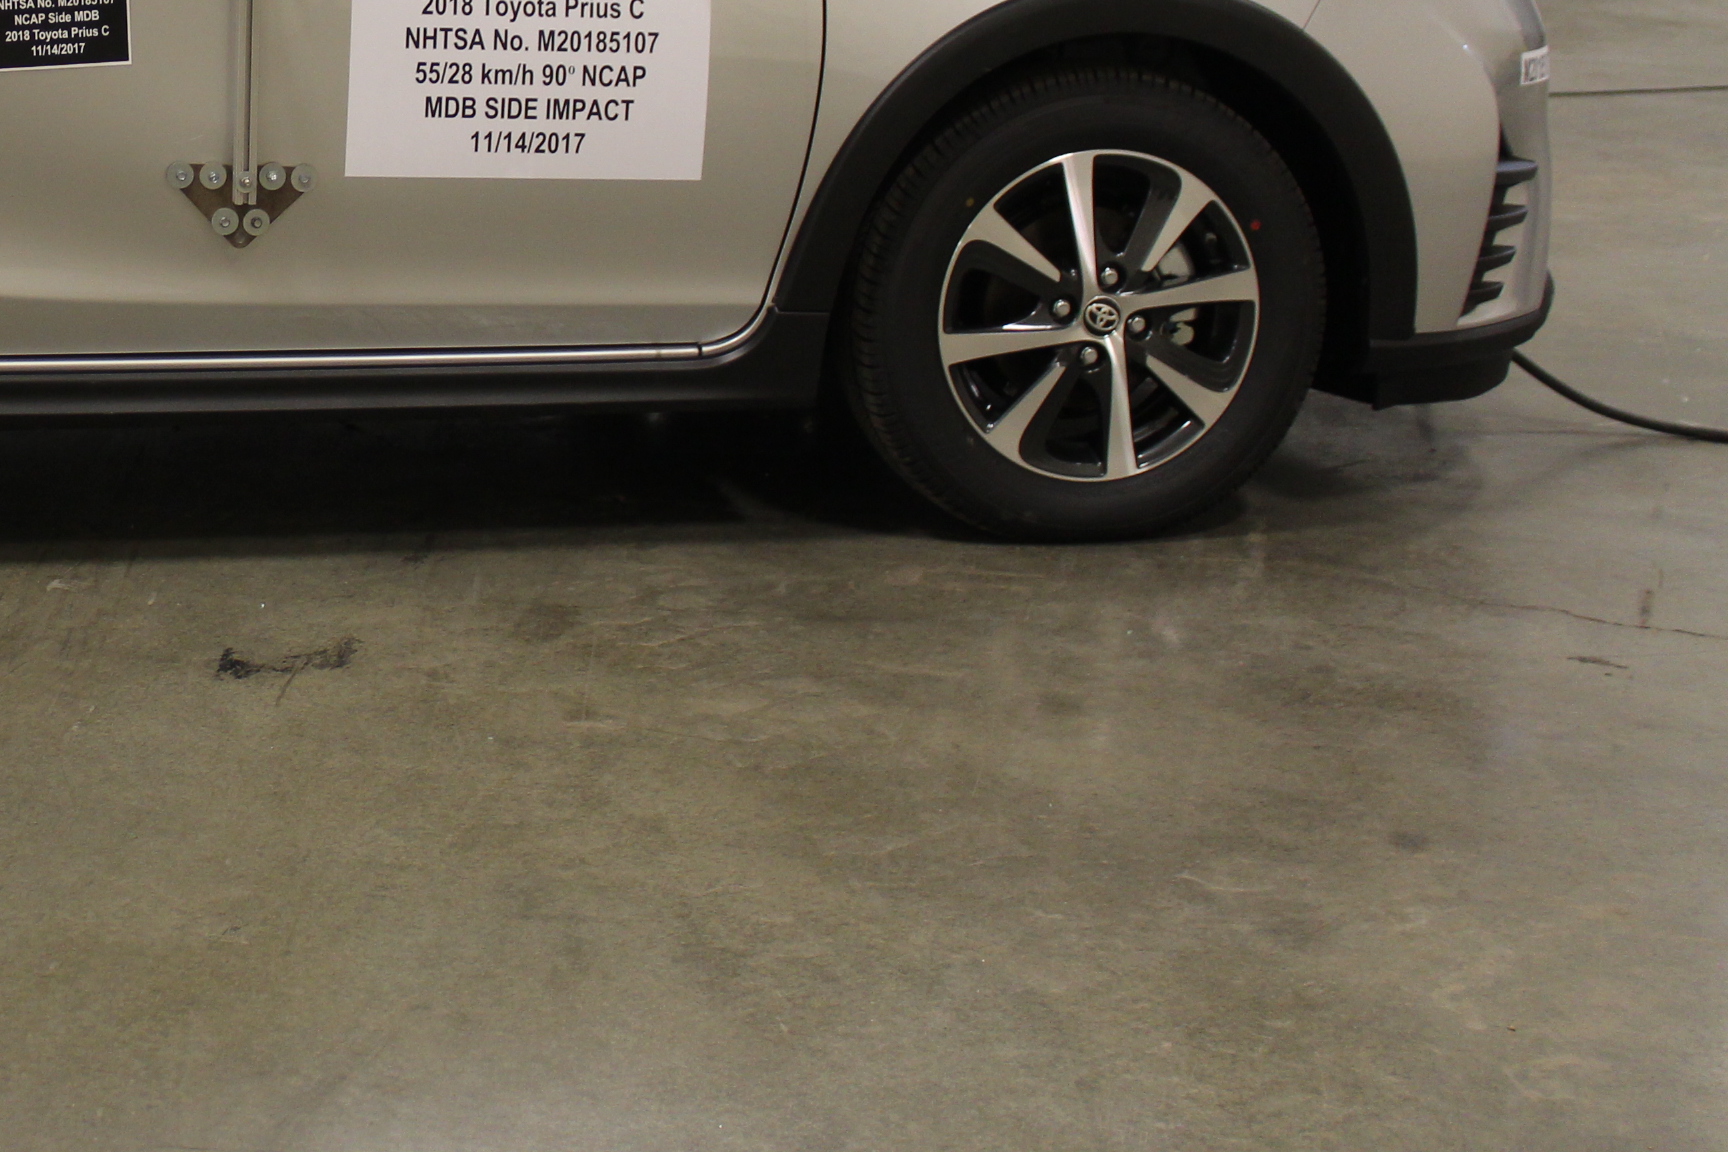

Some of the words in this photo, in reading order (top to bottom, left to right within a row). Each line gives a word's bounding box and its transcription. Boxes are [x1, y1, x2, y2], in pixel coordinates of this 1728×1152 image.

[14, 12, 46, 26] NCAP
[47, 11, 72, 24] Side
[74, 9, 100, 22] MDB
[5, 29, 31, 43] 2018
[32, 28, 69, 43] Toyota
[71, 26, 99, 38] Prius
[101, 25, 110, 36] C
[405, 26, 486, 51] NHTSA
[493, 28, 529, 52] No.
[537, 29, 660, 54] M20185107
[31, 42, 86, 57] 11/14/2017
[415, 61, 473, 85] 55/28
[481, 62, 534, 86] km/h
[582, 64, 647, 88] NCAP
[424, 96, 477, 119] MDB
[484, 96, 538, 120] SIDE
[545, 98, 635, 122] IMPACT
[470, 130, 586, 154] 11/14/2017
